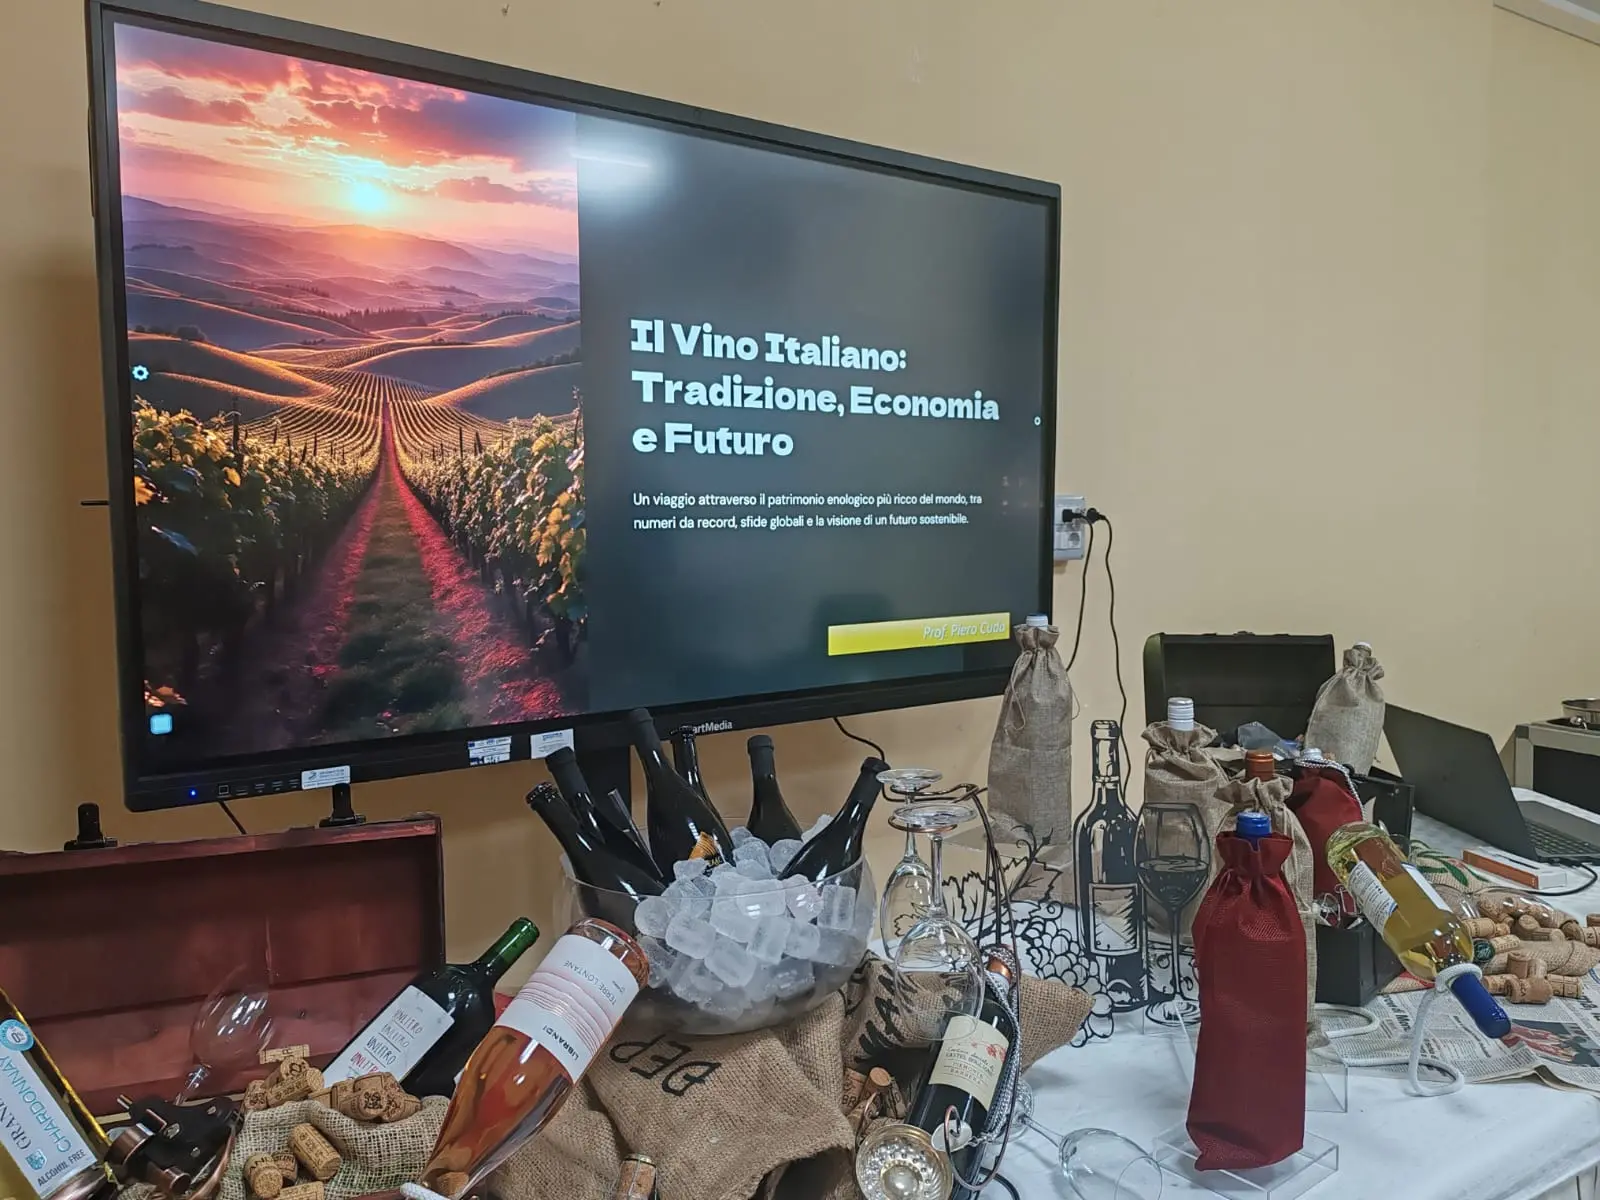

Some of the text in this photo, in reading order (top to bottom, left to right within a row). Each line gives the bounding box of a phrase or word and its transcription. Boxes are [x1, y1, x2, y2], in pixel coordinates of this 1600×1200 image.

[630, 318, 907, 372] Il Vino Italiano:
[631, 369, 1000, 421] Tradizione, Economia
[632, 421, 794, 457] e Futuro
[633, 492, 983, 509] Un viaggio attraverso il patrimonio enologico più ricco del mondo, tra
[633, 513, 969, 531] numeri da record, sfide globali e la visione di un futuro sostenibile.
[950, 623, 977, 637] Piero
[692, 720, 733, 734] artMedia
[563, 960, 598, 986] LONTANE
[598, 983, 617, 1006] TERRE
[366, 1036, 397, 1065] UNLITRO
[542, 1024, 579, 1061] LIBRANDI
[350, 1051, 380, 1073] UNLITR
[0, 1055, 72, 1153] CHARDONNAY
[0, 1097, 32, 1150] GRAN
[37, 1148, 86, 1186] ALCOHOL FREE
